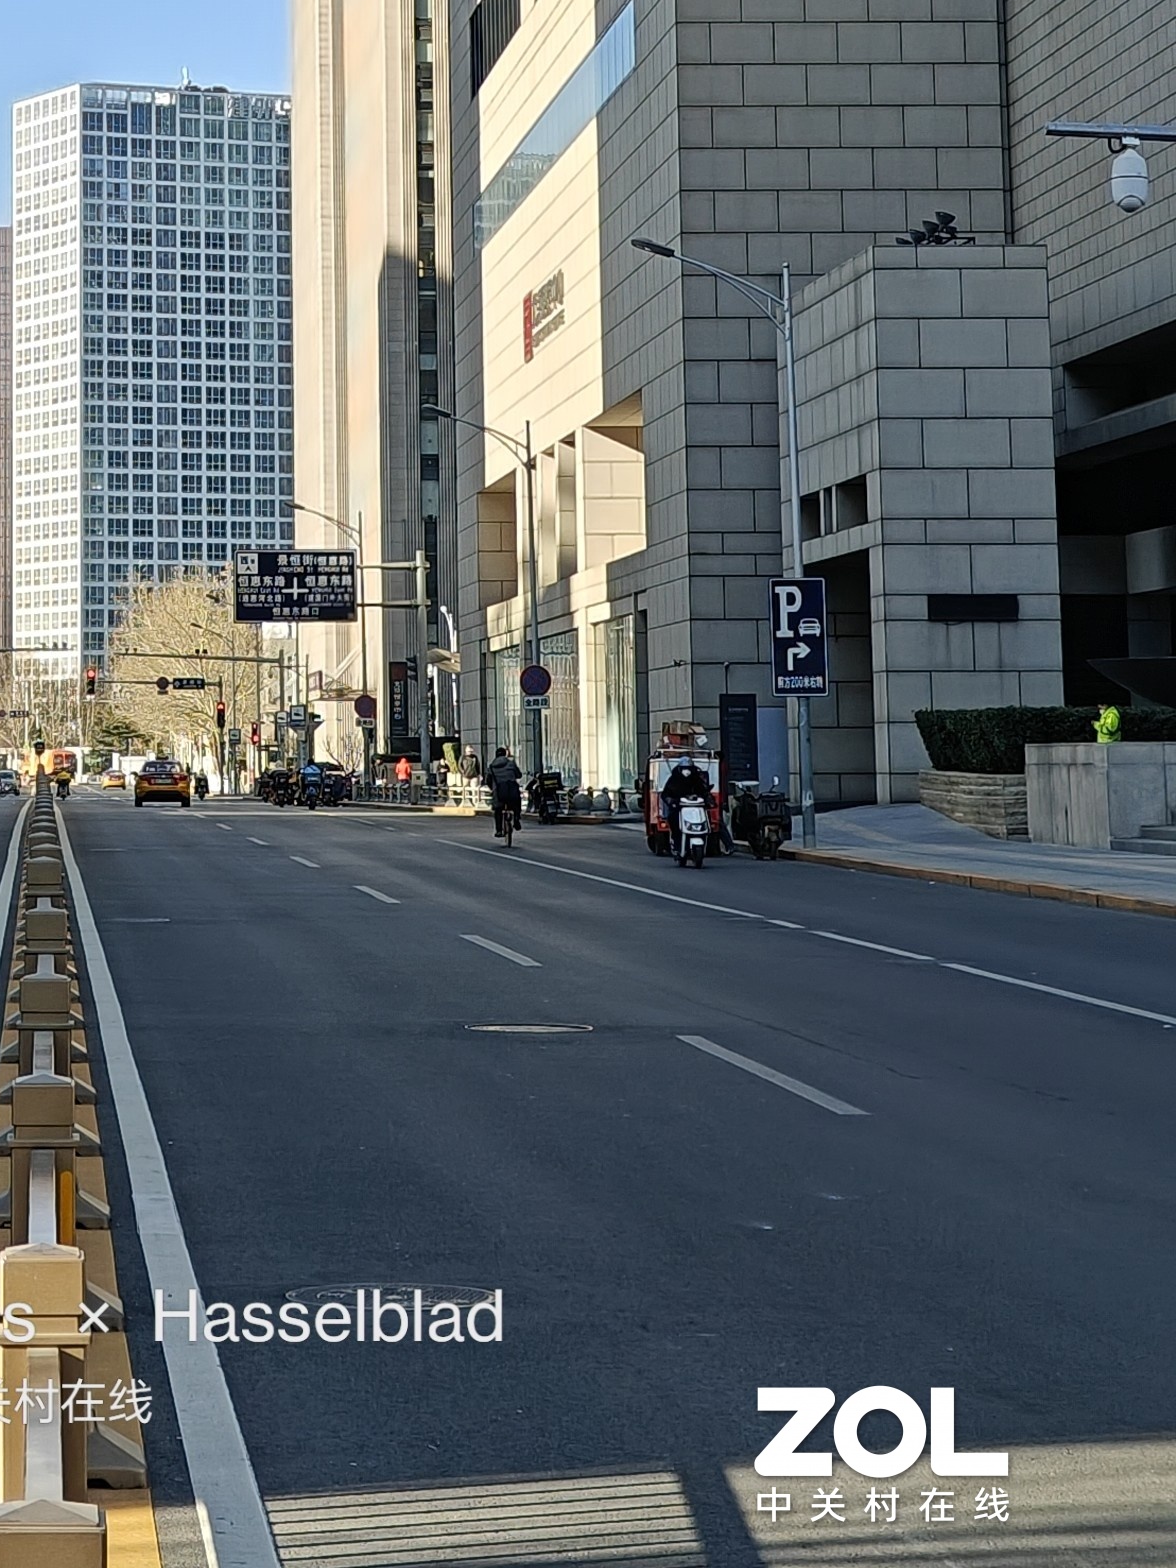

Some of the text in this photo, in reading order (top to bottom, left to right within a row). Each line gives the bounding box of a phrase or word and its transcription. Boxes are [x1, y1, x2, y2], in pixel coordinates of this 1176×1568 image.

[238, 575, 286, 587] 恒惠东路
[305, 575, 353, 587] 恒惠东路
[775, 585, 802, 638] P
